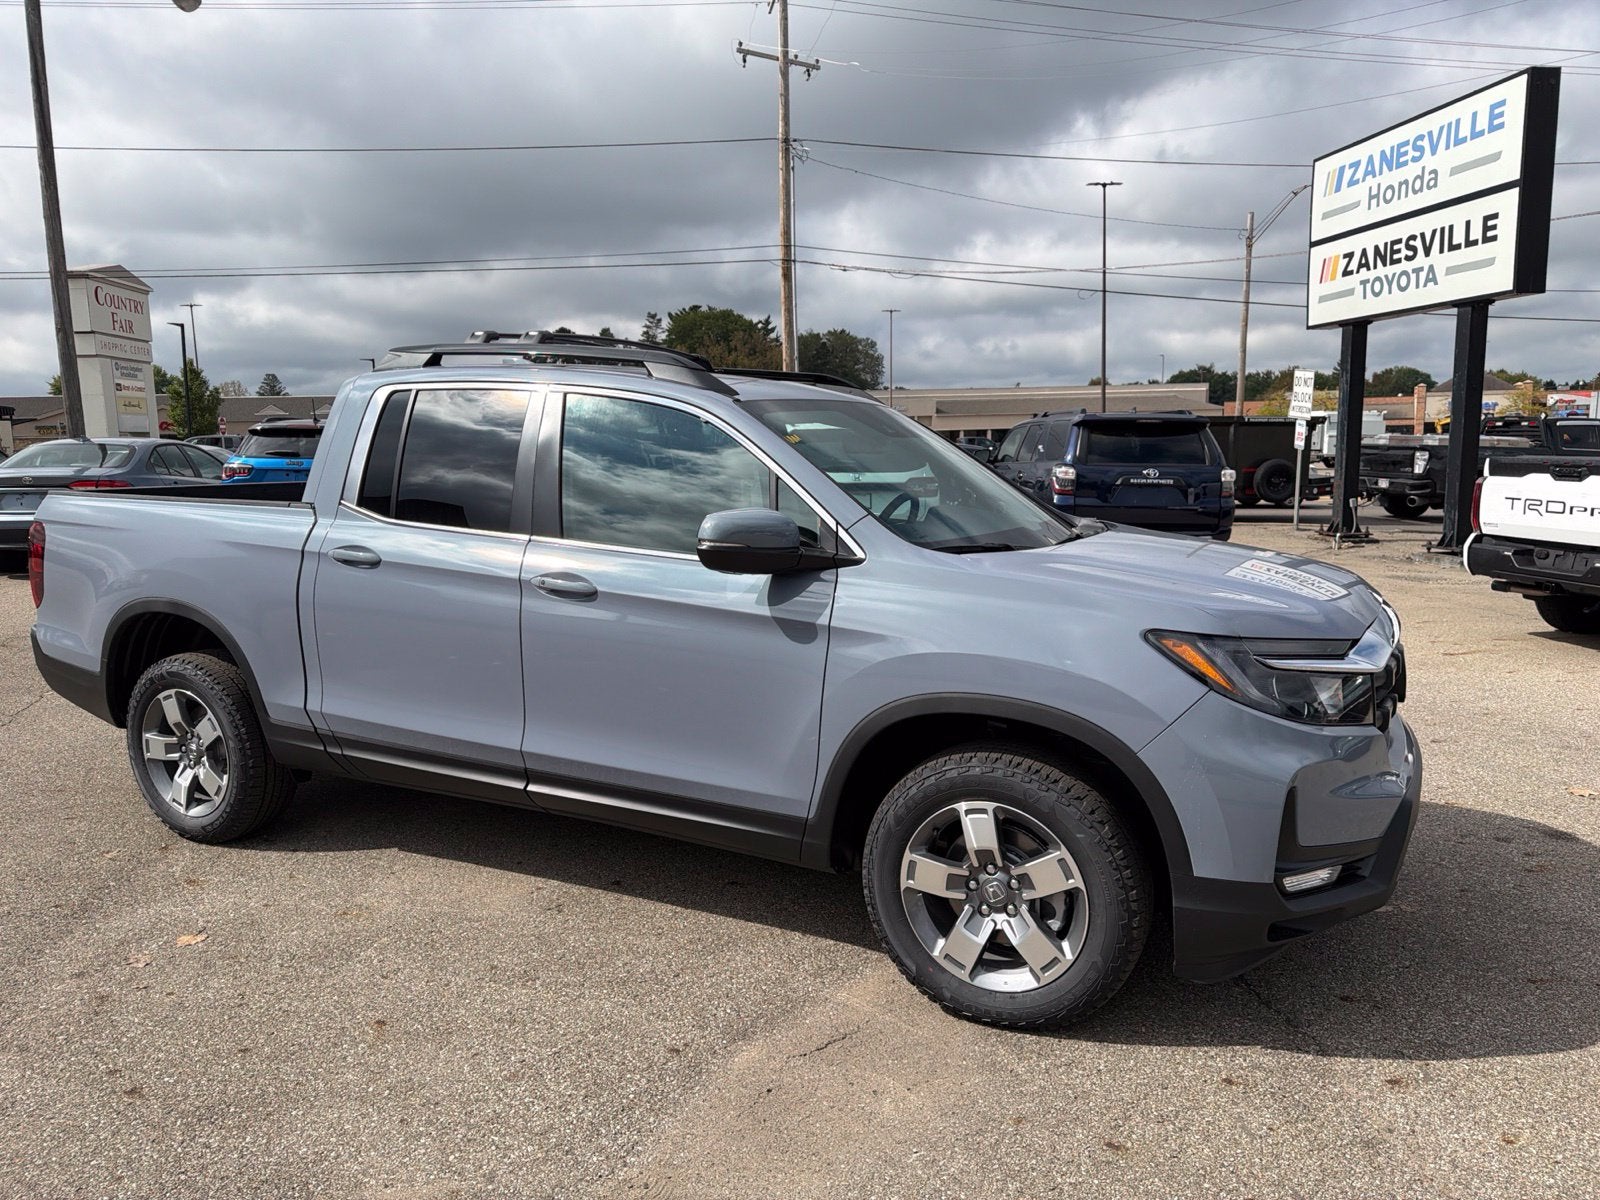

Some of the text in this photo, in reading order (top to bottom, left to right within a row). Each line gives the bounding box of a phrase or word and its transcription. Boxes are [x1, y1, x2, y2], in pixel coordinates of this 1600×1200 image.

[1346, 98, 1507, 188] ZANESVILLE
[1367, 165, 1439, 211] Honda
[1341, 212, 1500, 278] ZANESVILLE
[1359, 263, 1439, 300] TOYOTA
[100, 340, 127, 353] SHOPPING
[130, 345, 150, 356] CENTER
[1294, 376, 1314, 388] DO NOT
[1293, 391, 1312, 403] BLOCK
